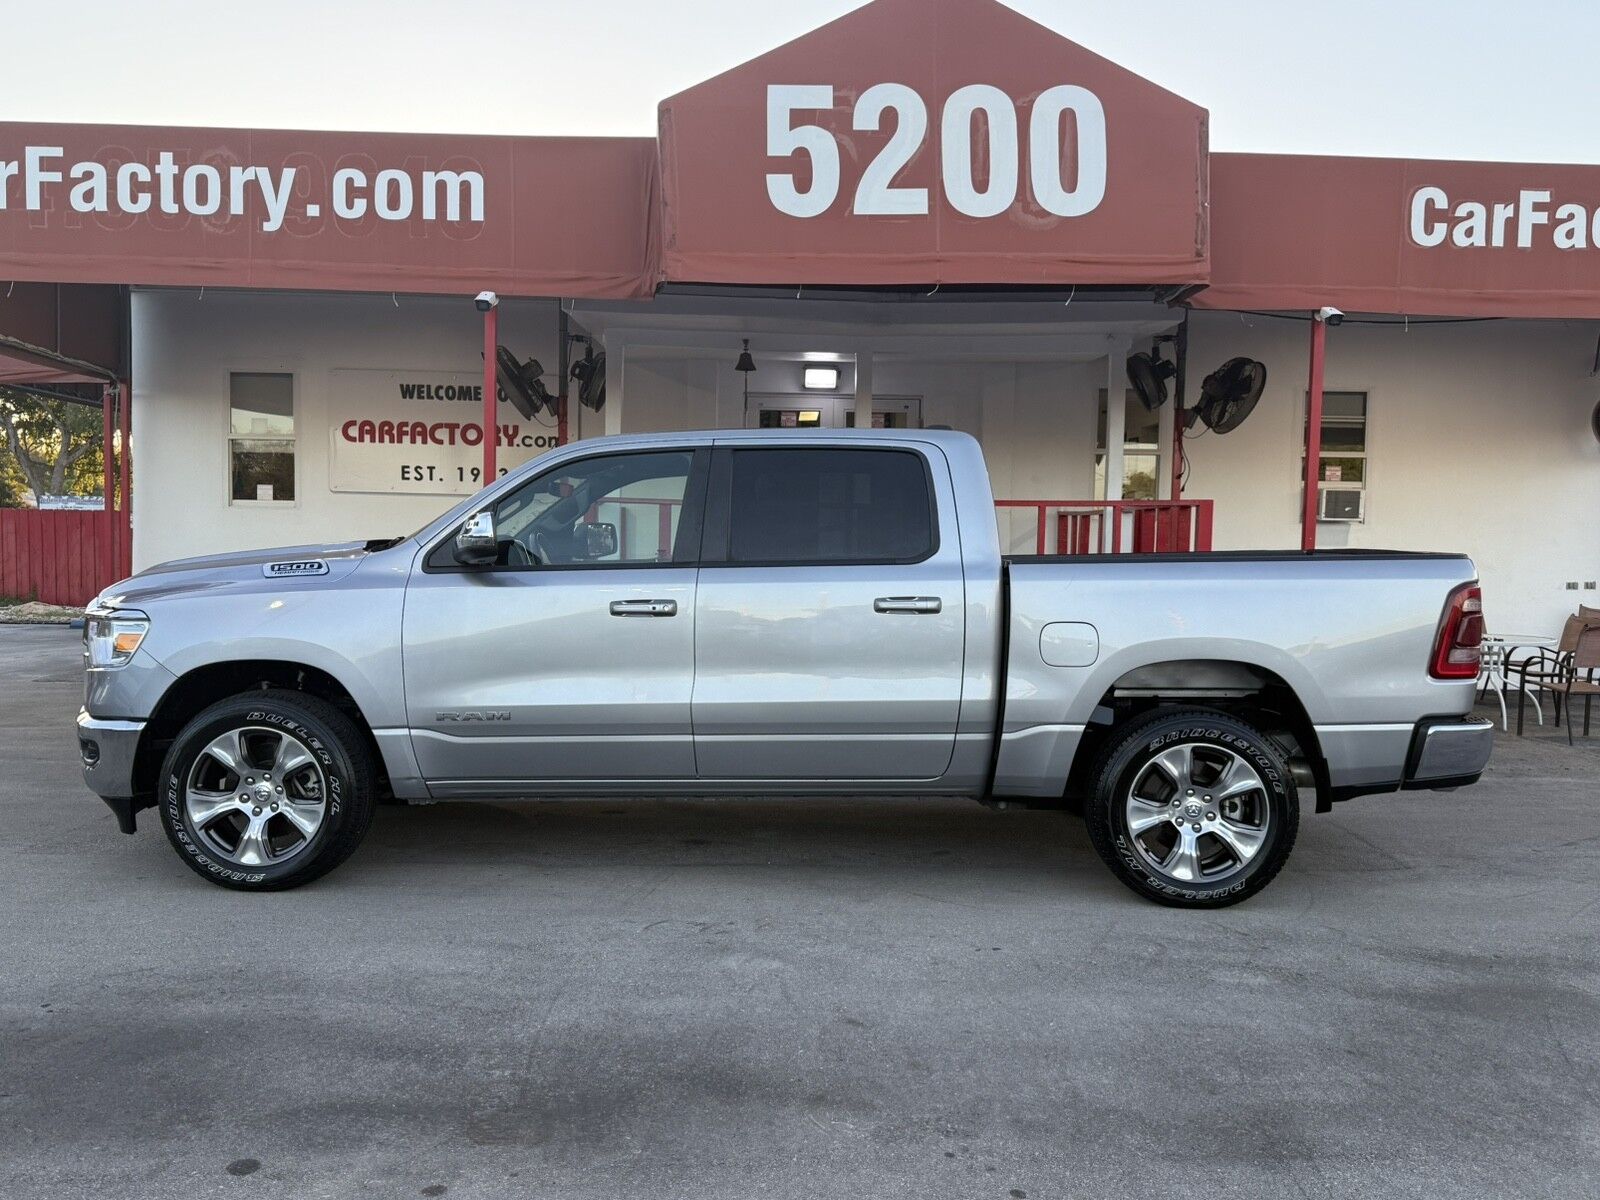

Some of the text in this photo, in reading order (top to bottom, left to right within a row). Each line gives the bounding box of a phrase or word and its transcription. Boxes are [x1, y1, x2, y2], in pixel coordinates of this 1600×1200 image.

[765, 83, 1107, 218] 5200
[400, 384, 482, 402] WELCOME
[401, 465, 444, 482] EST.
[273, 563, 319, 571] 1500
[436, 711, 511, 721] RAM
[247, 711, 332, 765] DUELER
[1149, 728, 1285, 795] BRIDGESTONE
[168, 774, 266, 882] BRIDGESTONE
[1146, 876, 1246, 900] DUELER
